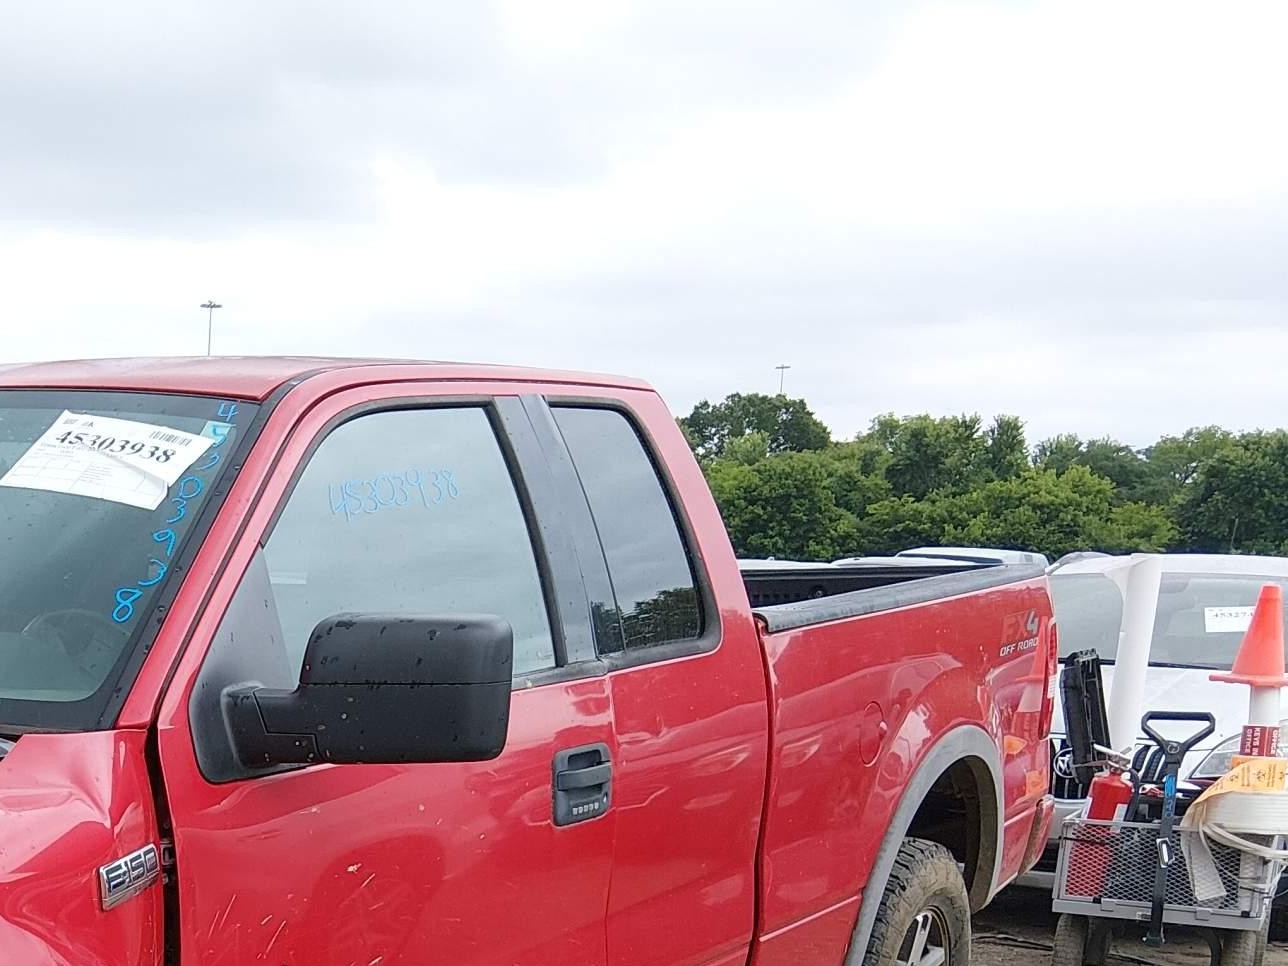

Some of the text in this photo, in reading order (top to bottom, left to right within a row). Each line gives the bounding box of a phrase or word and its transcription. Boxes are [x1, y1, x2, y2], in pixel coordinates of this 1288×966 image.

[55, 429, 177, 464] 45303938
[328, 468, 460, 521] 45303938
[999, 637, 1040, 657] OFF ROAD
